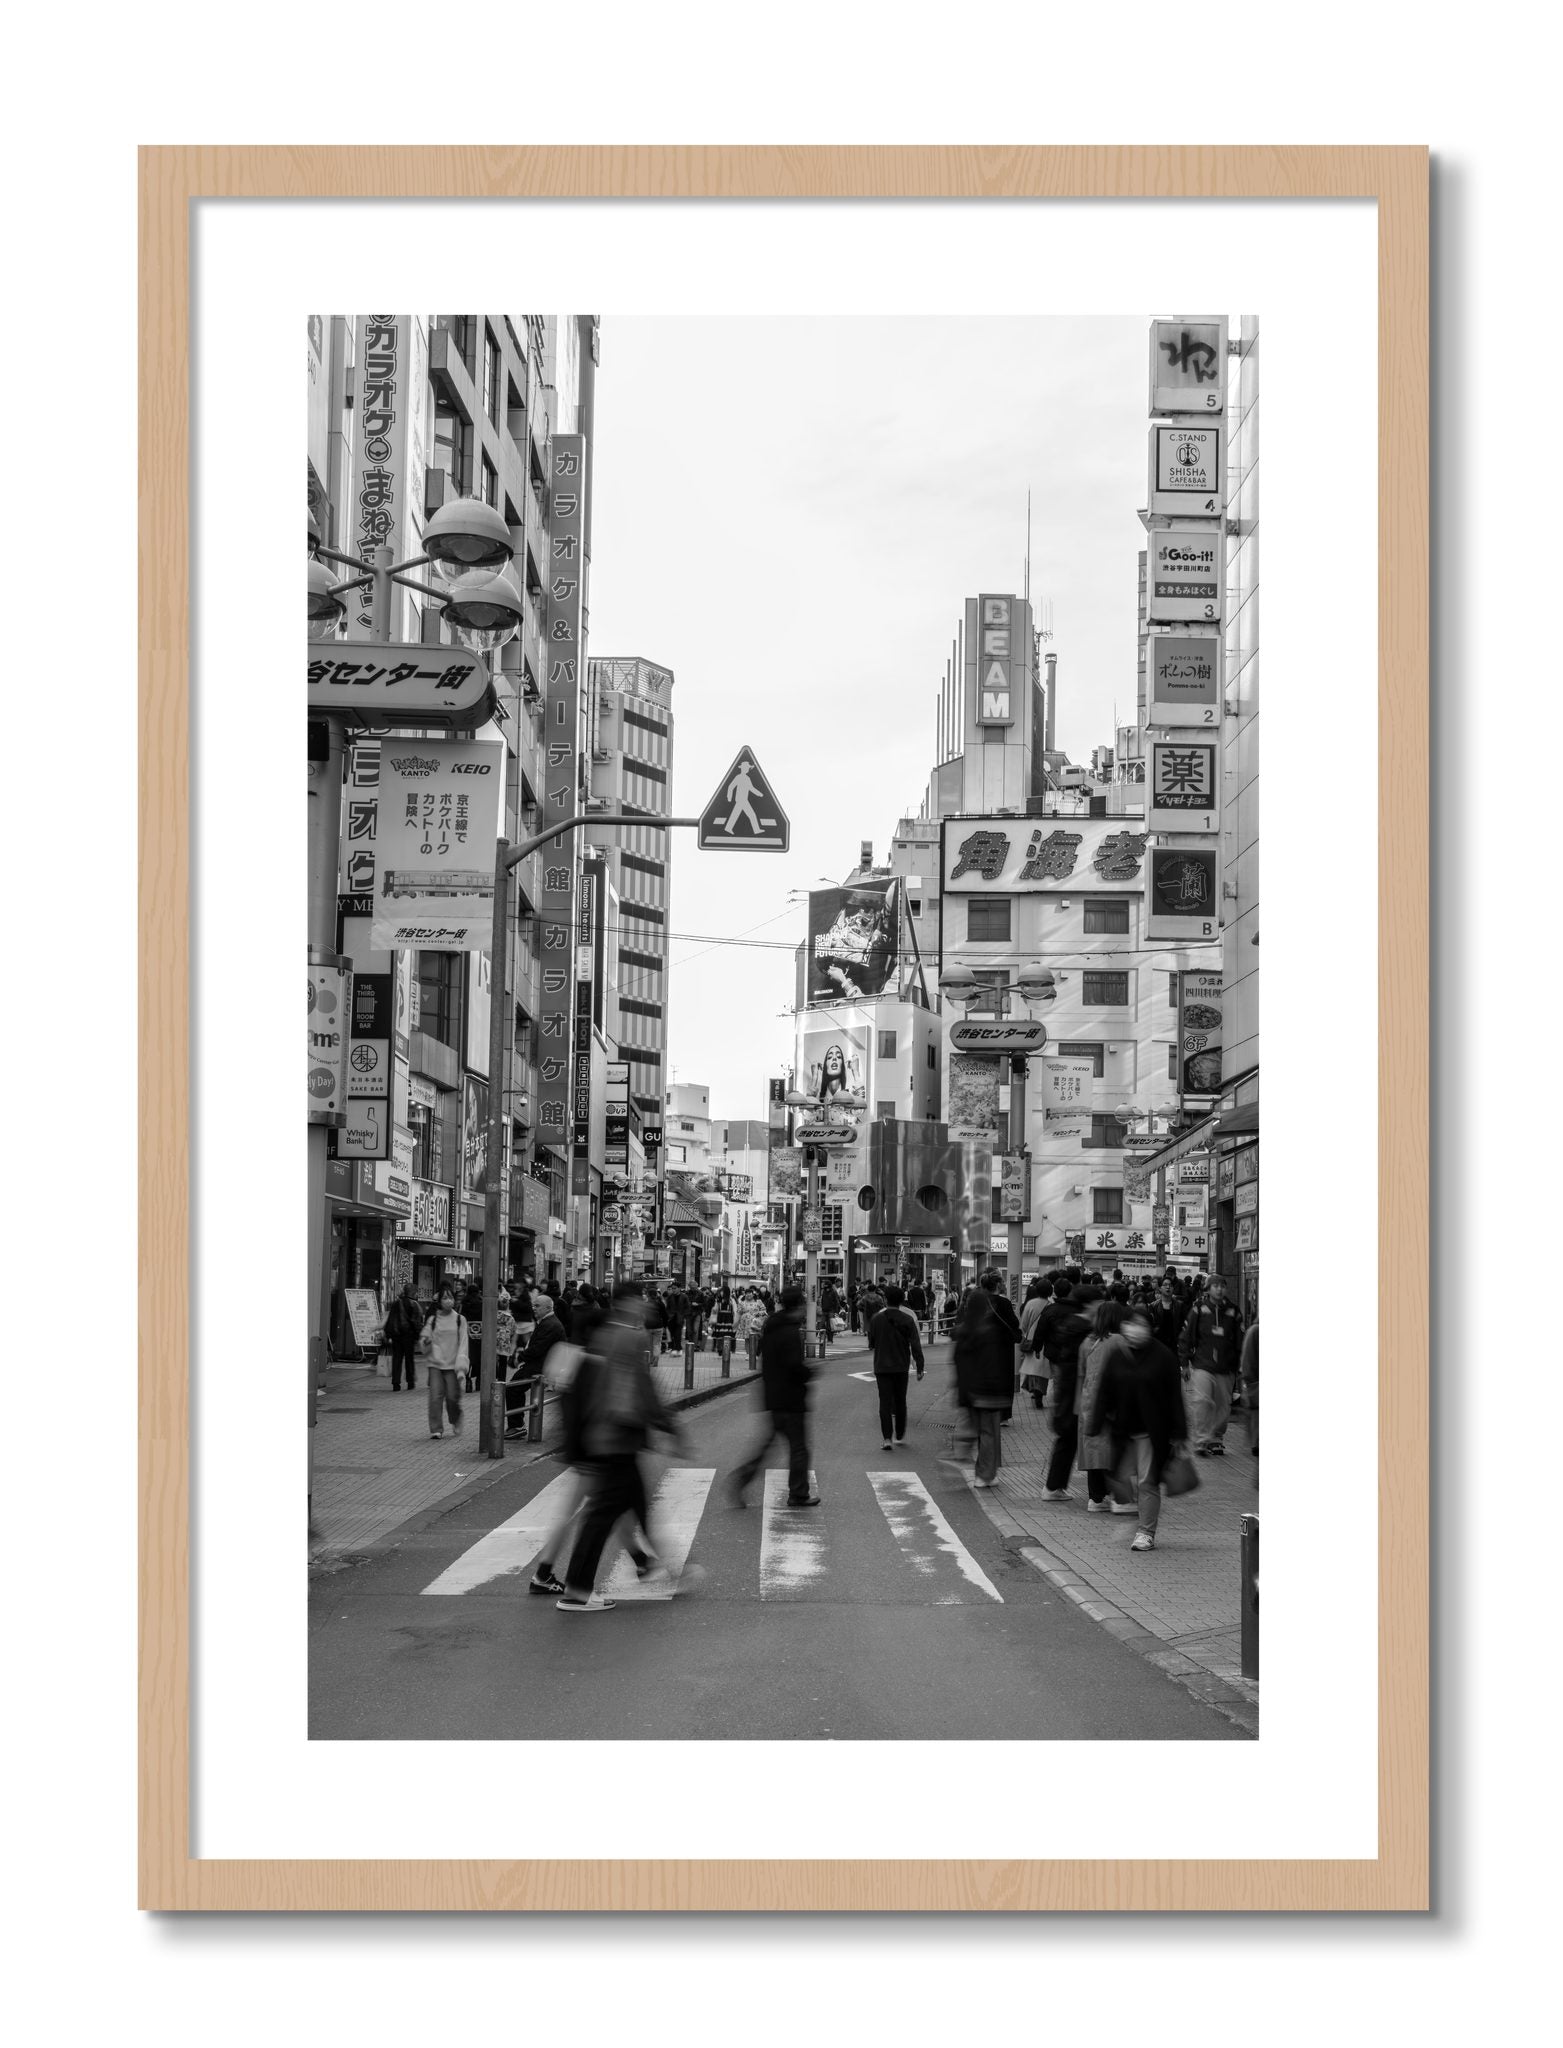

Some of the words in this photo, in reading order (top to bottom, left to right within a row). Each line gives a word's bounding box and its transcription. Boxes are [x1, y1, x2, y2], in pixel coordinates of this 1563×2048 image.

[363, 324, 398, 439] カラオケ
[1206, 395, 1216, 407] 5
[1169, 433, 1207, 442] C.STAND
[1169, 467, 1206, 476] SHISHA
[1169, 476, 1206, 484] CAFE&BAR
[1205, 499, 1215, 512] 4
[1168, 548, 1213, 561] Goo-it!
[1158, 585, 1214, 595] 全身もみほぐし
[1204, 604, 1214, 618] 3
[983, 599, 1010, 718] BEAM
[1204, 709, 1214, 722] 2
[451, 763, 491, 775] KEIO
[1162, 750, 1203, 792] 薬
[405, 793, 418, 828] 冒険へ
[420, 793, 435, 855] カントーの
[455, 793, 469, 843] 京王線で
[1203, 817, 1210, 829] 1
[951, 830, 1150, 881] 角海老
[1157, 862, 1207, 902] 一蘭
[394, 928, 468, 938] 渋谷センター街
[581, 912, 589, 941] hearts
[1203, 923, 1212, 935] B
[956, 1028, 1041, 1039] 渋谷センター街
[1184, 1035, 1208, 1052] 6F
[346, 1129, 374, 1139] Whisky
[645, 1132, 661, 1141] GU
[1096, 1231, 1145, 1249] 兆楽
